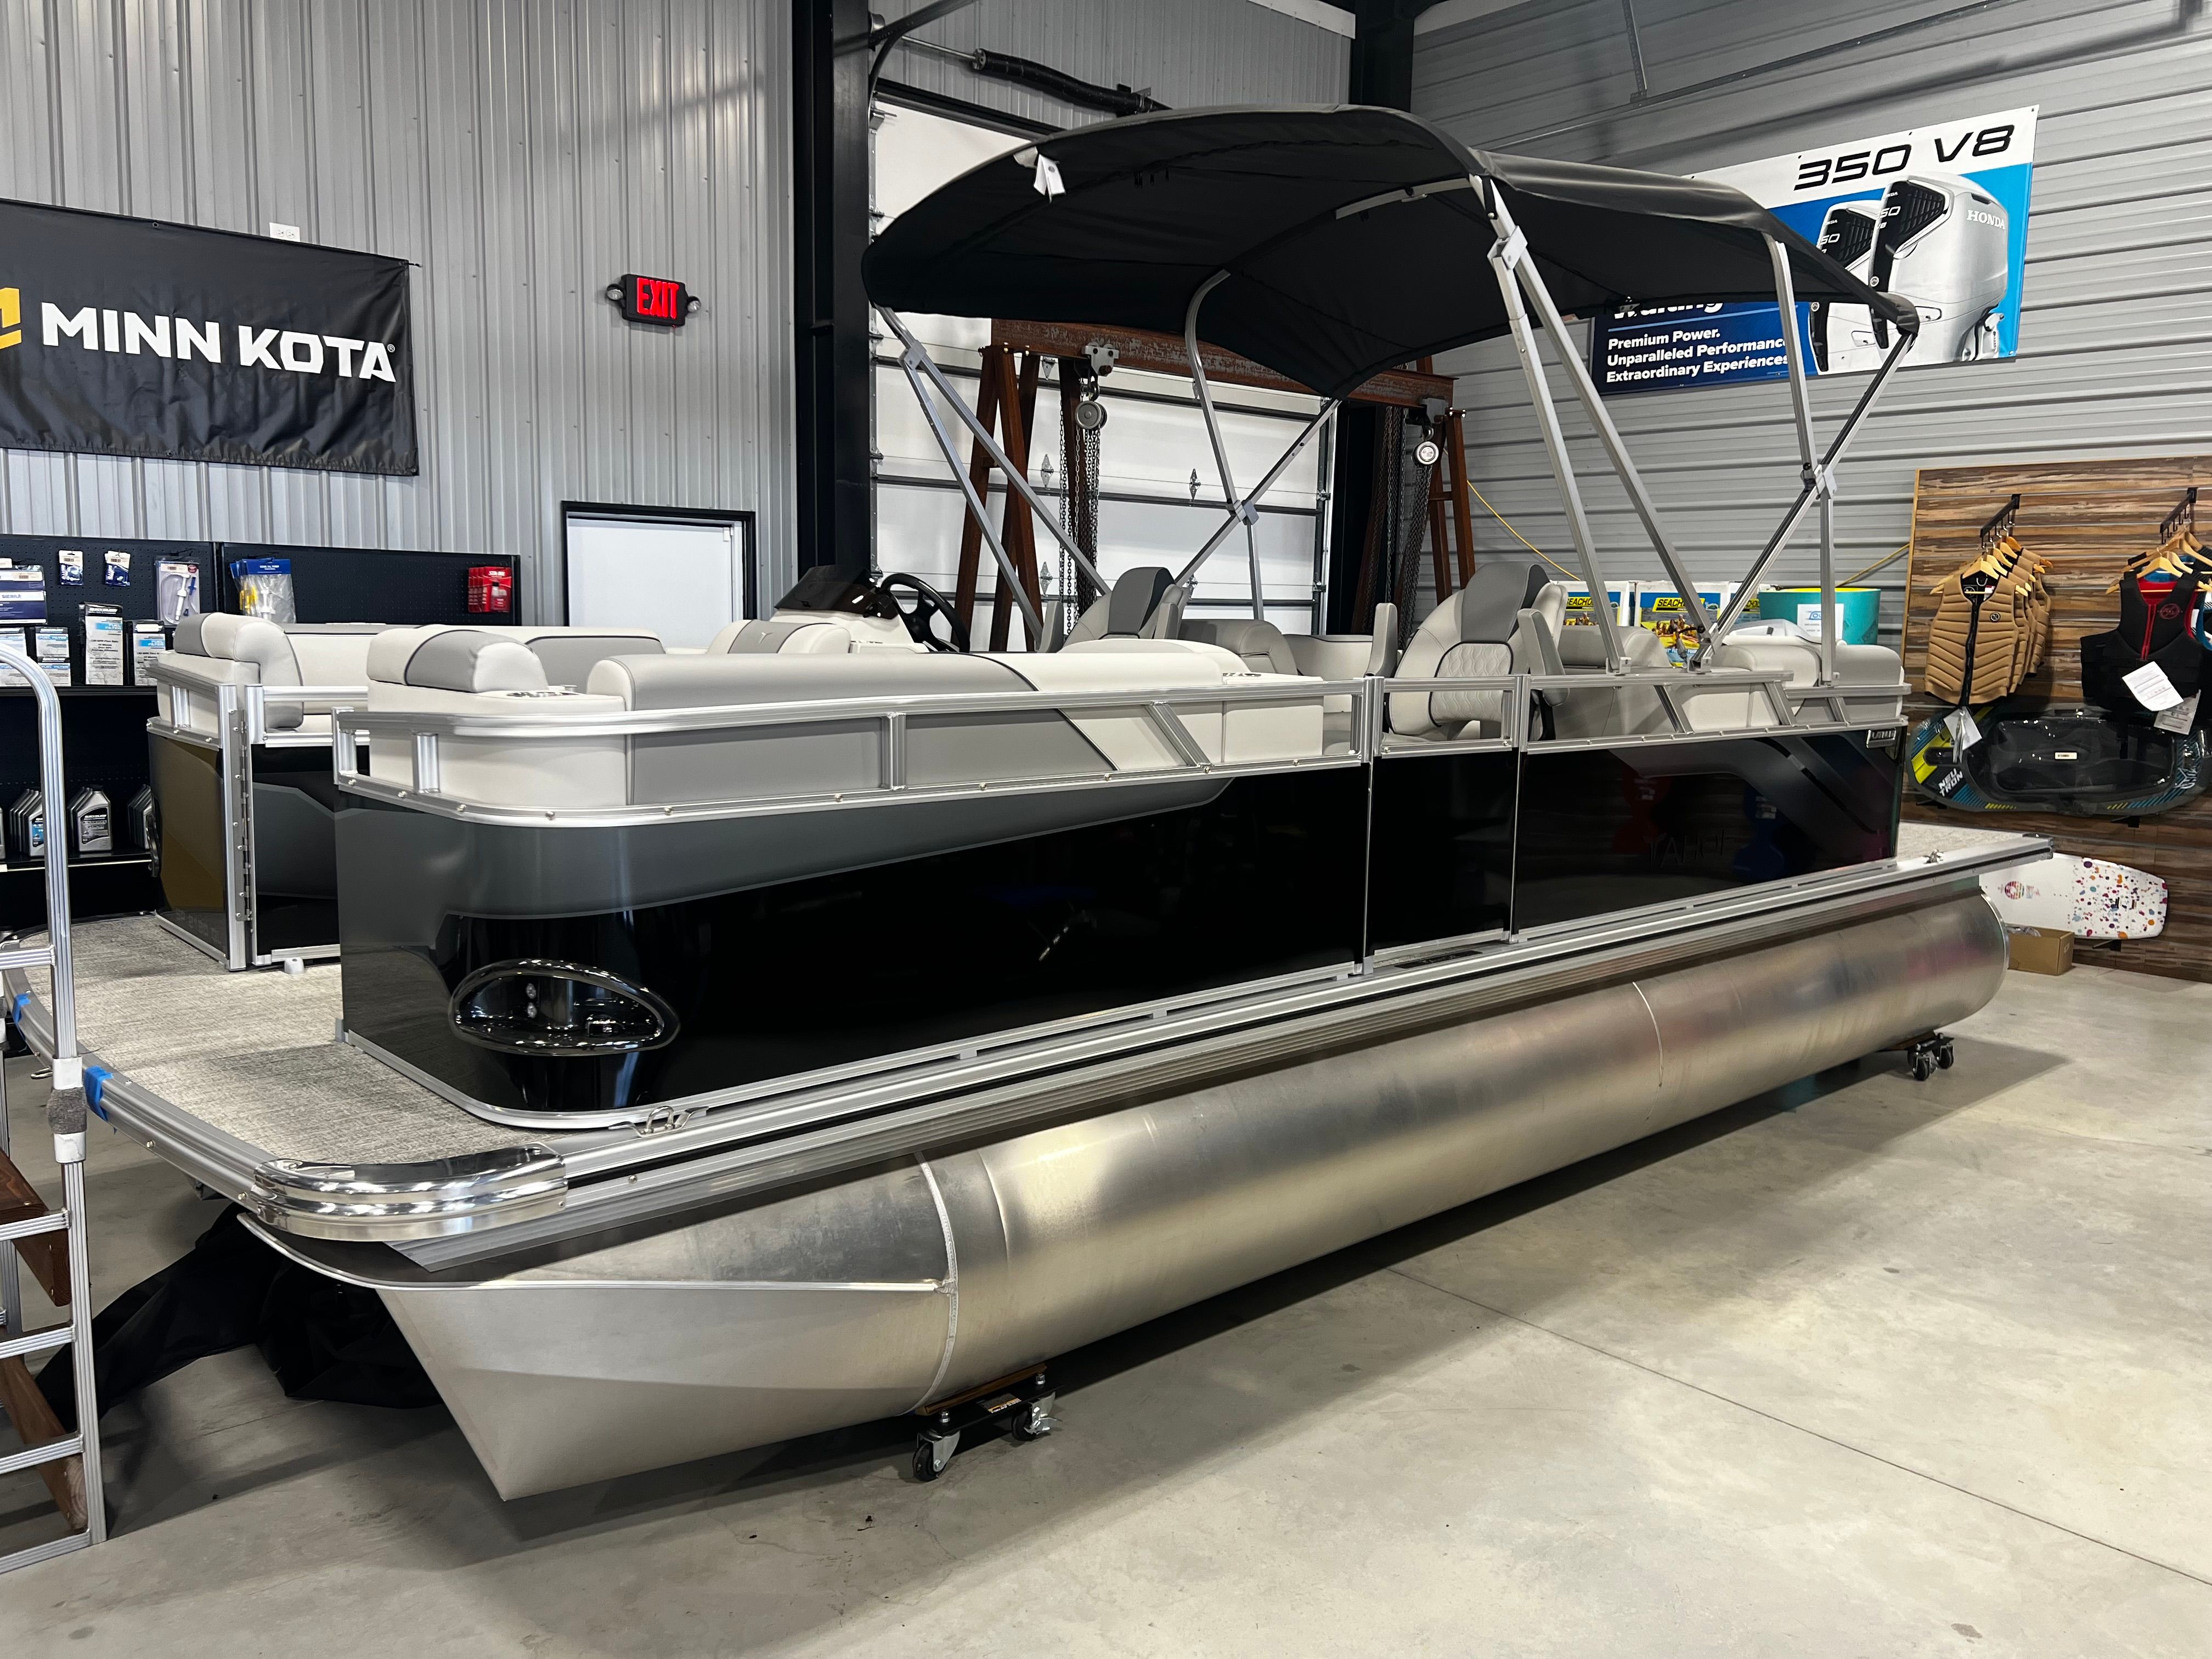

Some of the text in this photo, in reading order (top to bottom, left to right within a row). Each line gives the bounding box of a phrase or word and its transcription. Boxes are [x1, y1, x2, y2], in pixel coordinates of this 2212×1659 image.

[1793, 124, 2015, 191] 350 V8
[1966, 210, 2005, 230] HONDA
[636, 277, 680, 319] EXIT
[41, 302, 396, 382] MINN KOTA
[1607, 337, 1786, 367] Unparalleled Performanc
[1608, 328, 1720, 350] Premium Power.
[1606, 364, 1701, 383] Extraordinary
[1938, 768, 1957, 789] NEU
[1939, 771, 1963, 797] TRON
